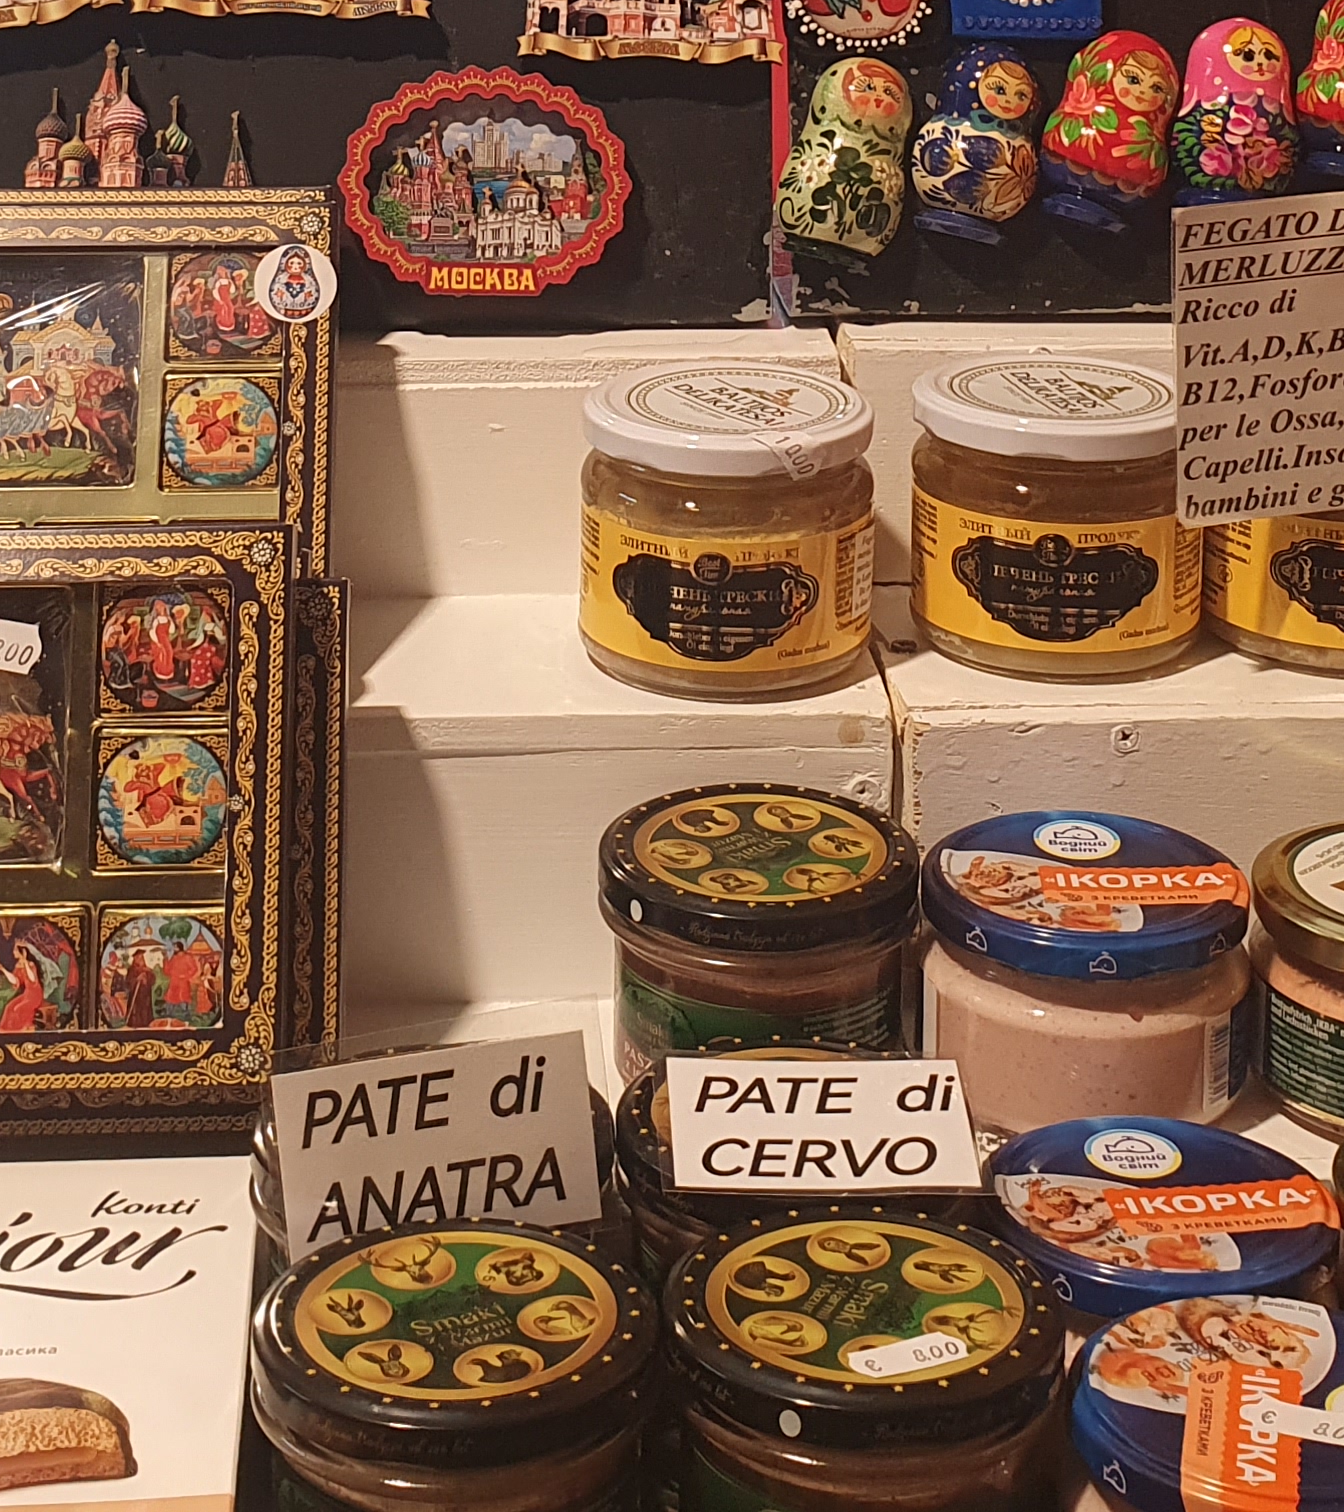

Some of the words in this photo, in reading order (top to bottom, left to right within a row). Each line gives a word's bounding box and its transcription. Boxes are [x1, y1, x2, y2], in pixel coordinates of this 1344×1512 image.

[1180, 210, 1318, 249] FEGATO
[429, 266, 536, 291] МОСКВА
[1180, 298, 1259, 324] Ricco
[1270, 288, 1297, 313] di
[1180, 421, 1228, 451] per
[1235, 413, 1260, 439] le
[1186, 482, 1298, 519] bambini
[1307, 488, 1320, 503] e
[1103, 893, 1198, 901] КРЕВЕТКАМИ
[302, 1069, 454, 1150] PATE
[489, 1054, 546, 1119] di
[694, 1076, 858, 1114] PATE
[896, 1074, 955, 1112] di
[700, 1136, 938, 1179] CERVO
[91, 1190, 201, 1218] Konti
[306, 1147, 567, 1244] ANATRA
[1184, 1216, 1288, 1230] КРЕВЕТКАМИ
